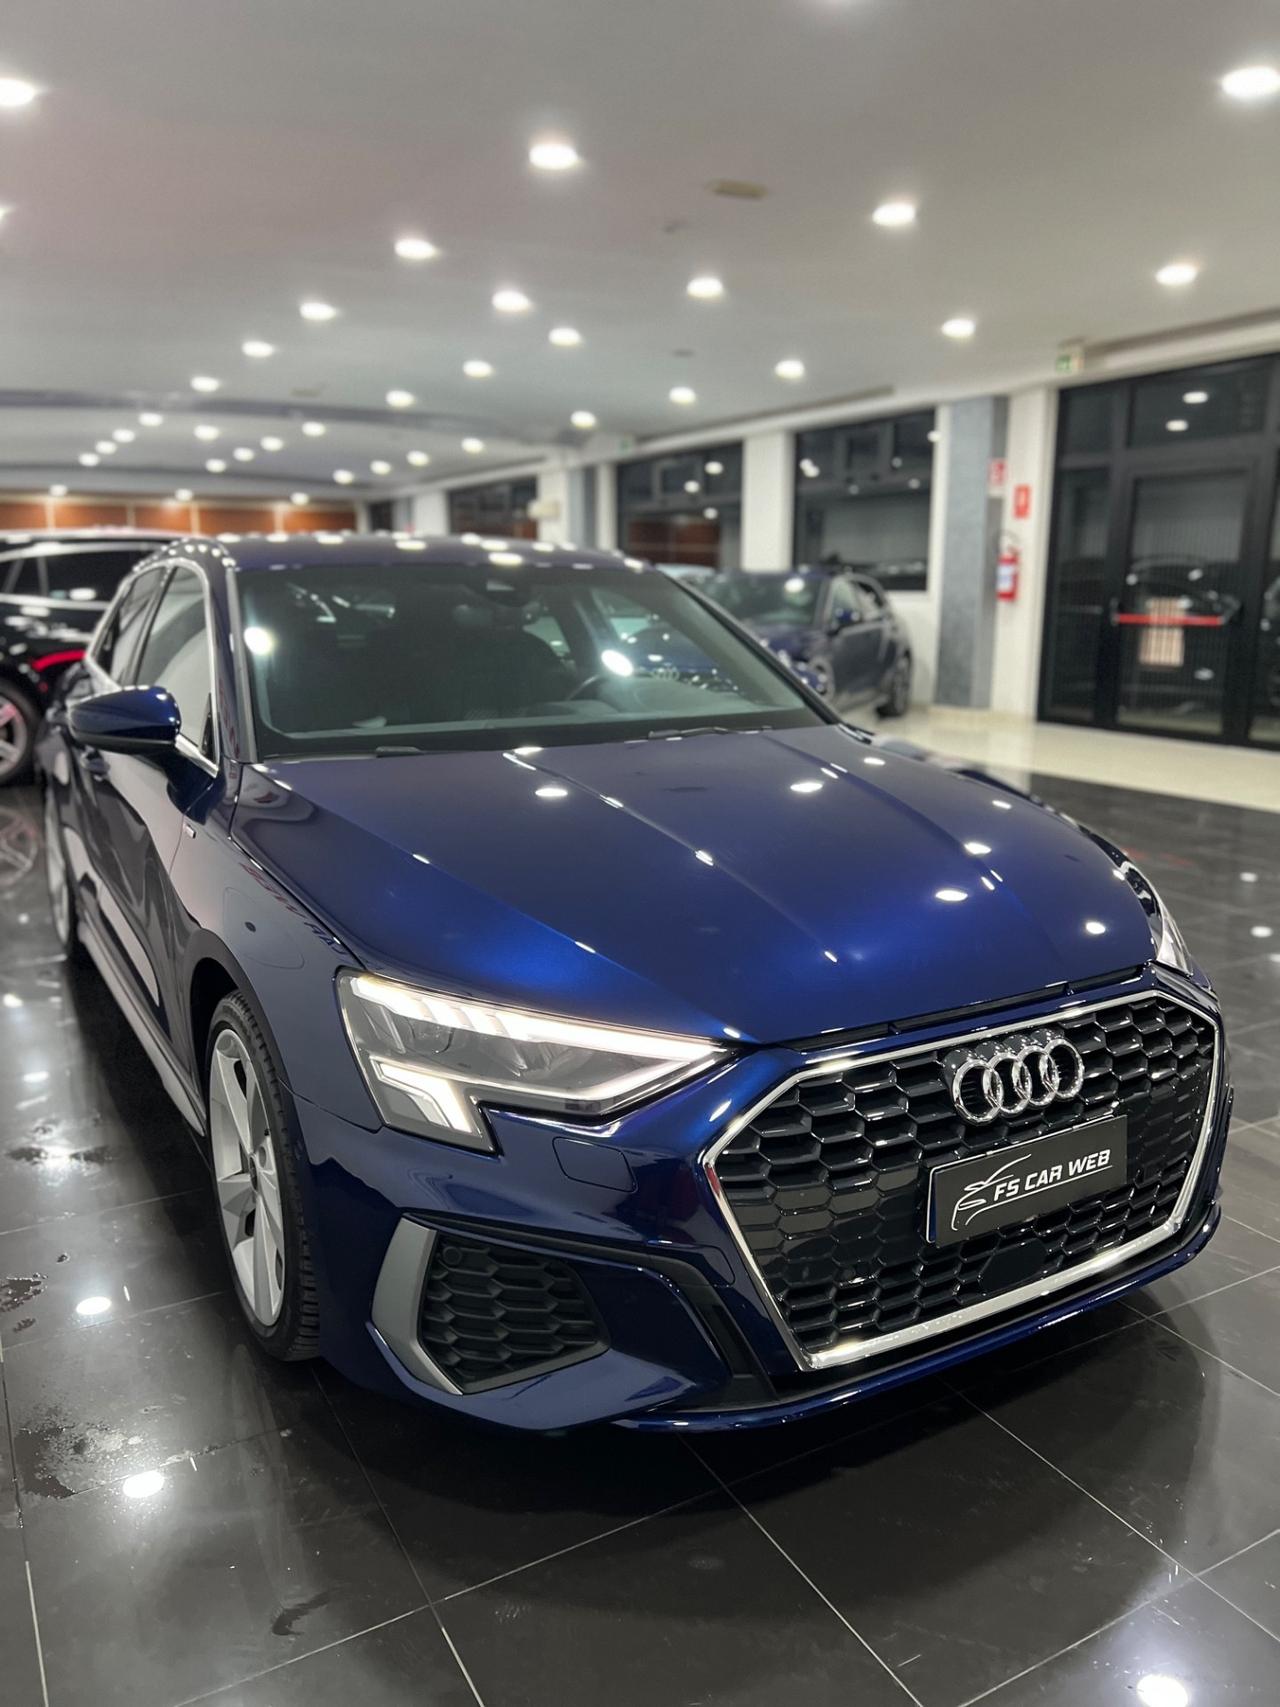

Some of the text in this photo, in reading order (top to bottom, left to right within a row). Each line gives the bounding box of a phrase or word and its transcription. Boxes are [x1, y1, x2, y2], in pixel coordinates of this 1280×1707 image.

[993, 1149, 1110, 1201] FS CAR WEB
